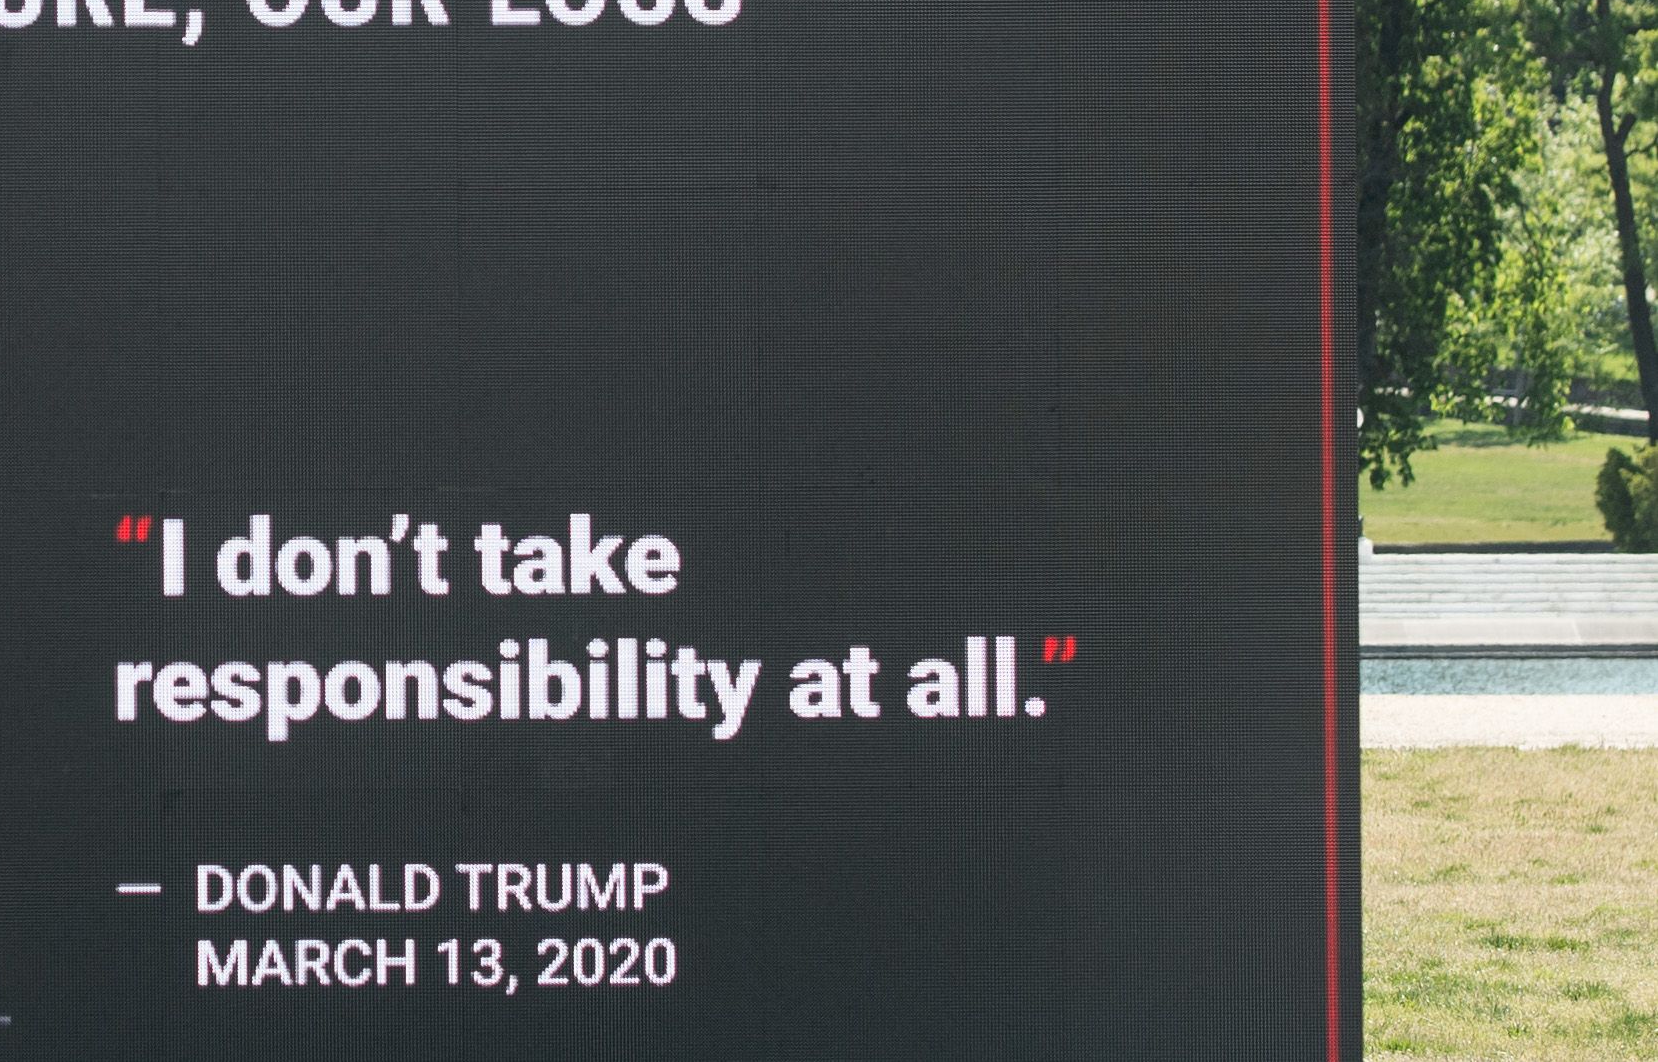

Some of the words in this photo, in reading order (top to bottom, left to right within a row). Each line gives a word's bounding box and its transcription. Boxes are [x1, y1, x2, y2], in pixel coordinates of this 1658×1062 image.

[216, 513, 449, 597] don’t
[474, 513, 681, 596] take
[115, 637, 762, 743] responsibility
[788, 646, 881, 718] at
[196, 862, 441, 913] DONALD
[455, 862, 669, 912] TRUMP
[196, 938, 416, 987] MARCH
[437, 938, 518, 995] 13,
[536, 937, 677, 986] 2020
